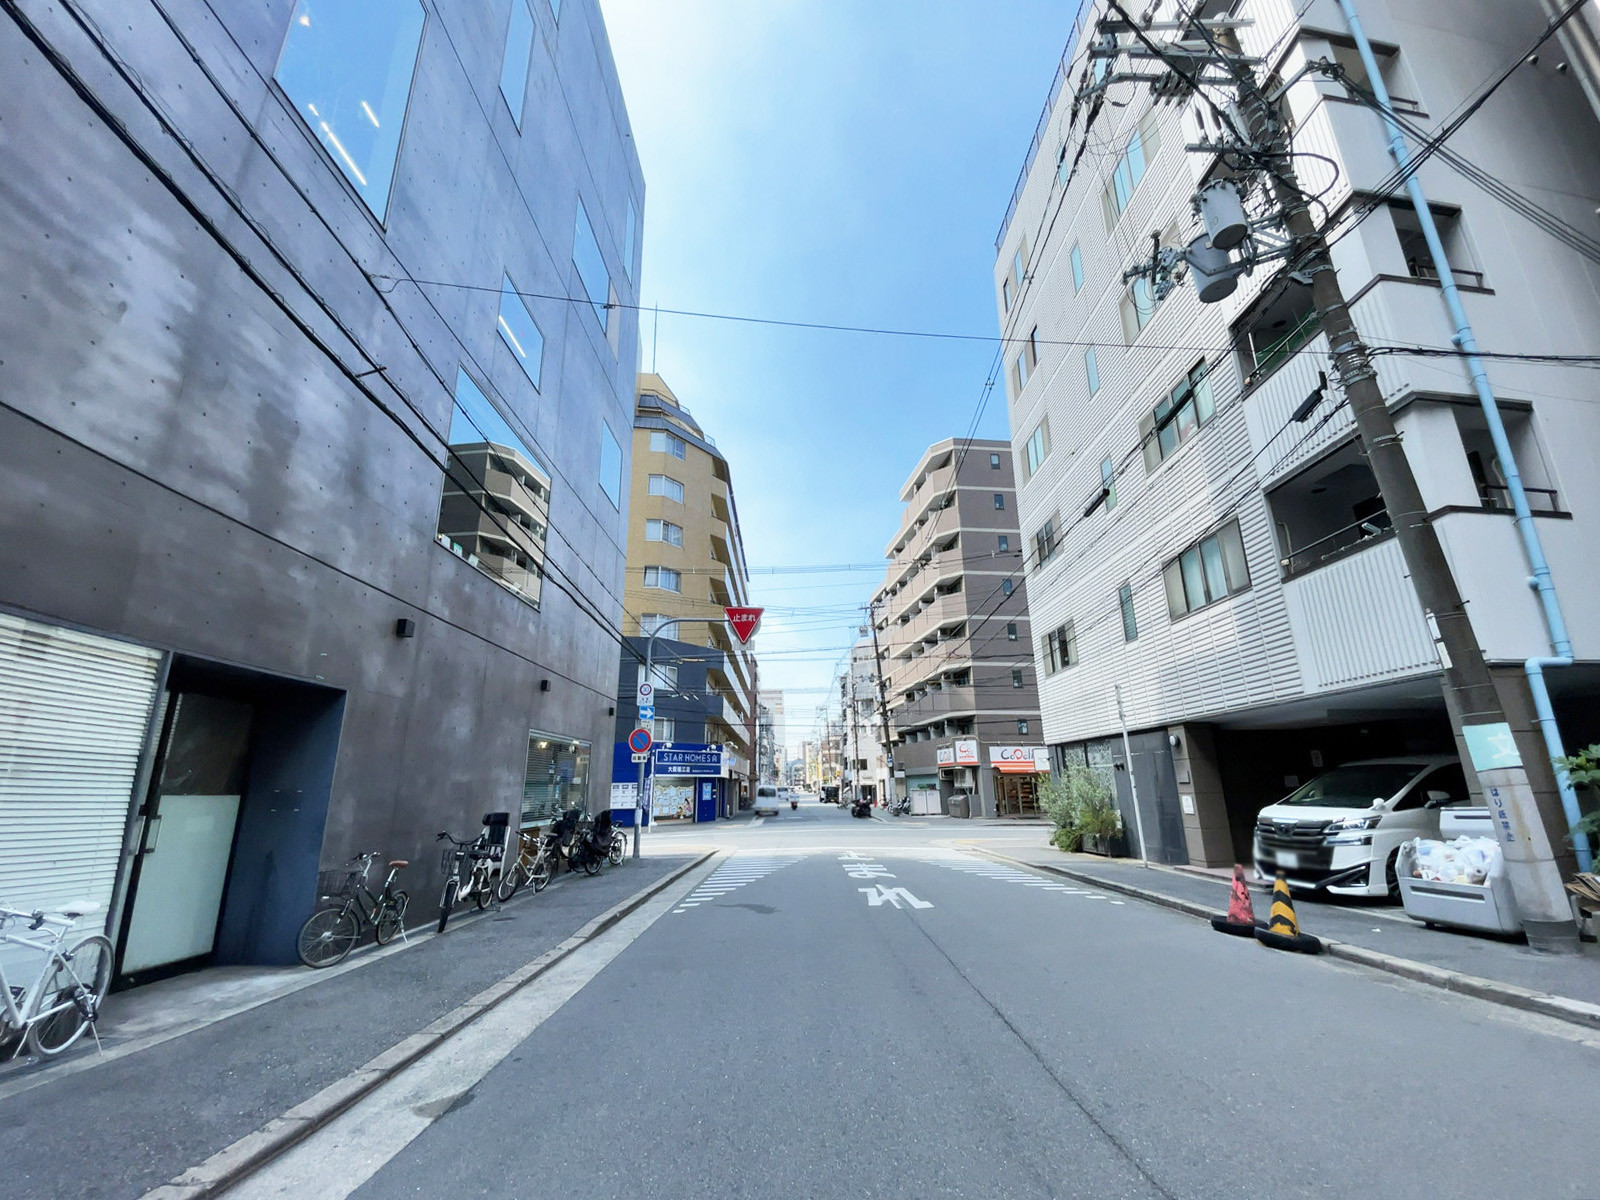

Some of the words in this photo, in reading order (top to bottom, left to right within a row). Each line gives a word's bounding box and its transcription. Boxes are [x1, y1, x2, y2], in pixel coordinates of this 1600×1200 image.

[733, 613, 756, 622] 止まれ
[663, 753, 683, 762] STAR
[684, 753, 711, 762] HOMES
